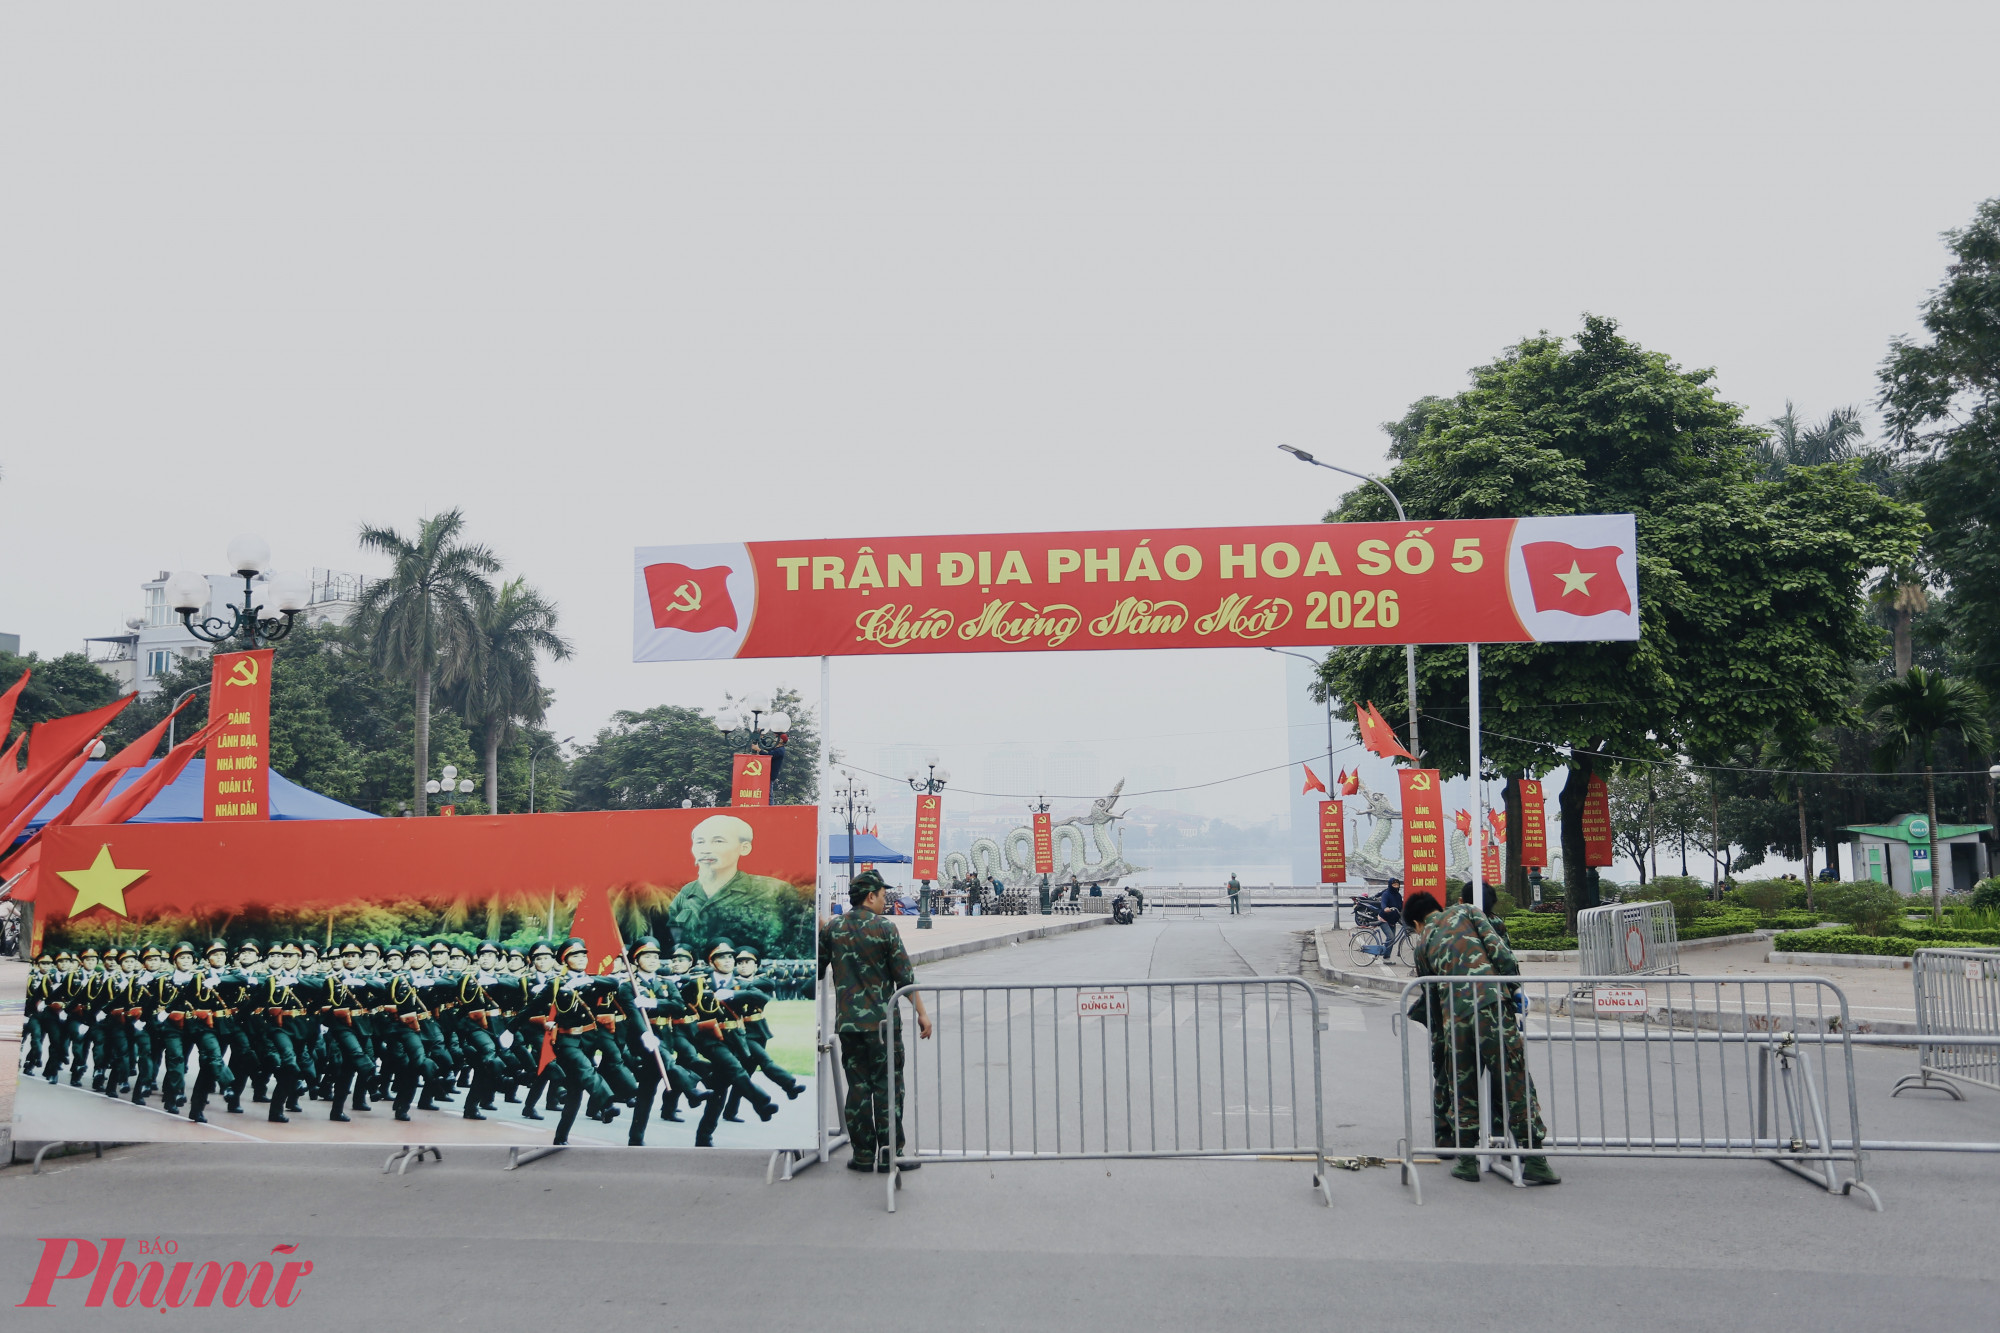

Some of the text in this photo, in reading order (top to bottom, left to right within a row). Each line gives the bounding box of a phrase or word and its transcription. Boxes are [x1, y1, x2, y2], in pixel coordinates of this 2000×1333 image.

[776, 527, 1484, 596] TRẬN ĐỊA PHÁO HOA SỐ 5
[855, 603, 955, 648] Chúc
[957, 598, 1083, 648] Mừng
[1194, 592, 1293, 639] Mới
[1305, 589, 1400, 630] 2026
[217, 733, 258, 750] LÃNH ĐẠO,
[216, 754, 258, 771] NHÀ NƯỚC
[218, 777, 255, 795] QUẢN LÝ,
[215, 800, 258, 817] NHÂN DÂN
[1414, 804, 1430, 815] ĐẢNG
[1411, 834, 1422, 843] NHÀ
[1413, 847, 1427, 858] QUẢN
[1411, 862, 1426, 872] NHÂN
[1412, 876, 1424, 886] LÀM
[1081, 1000, 1125, 1011] DỪNG LẠI
[1598, 996, 1644, 1008] DỪNG LẠI
